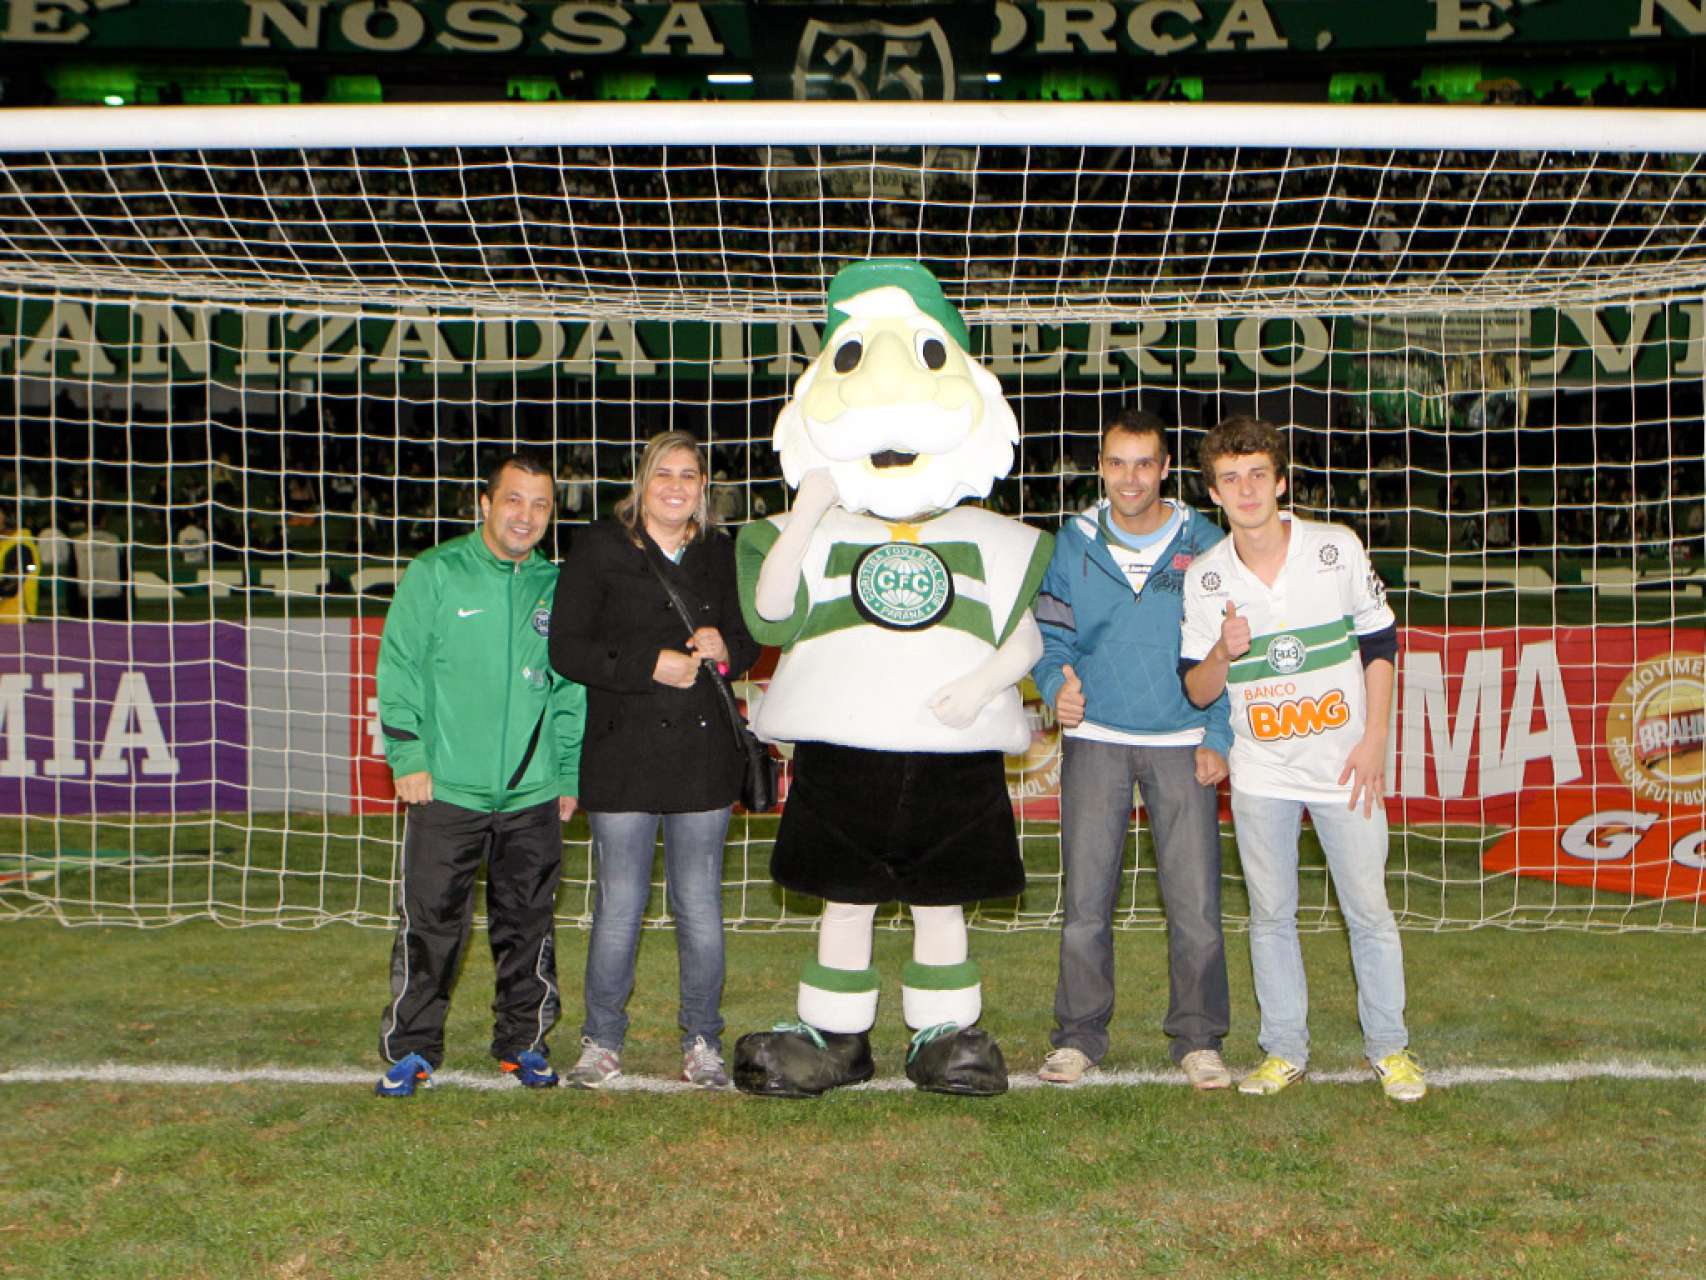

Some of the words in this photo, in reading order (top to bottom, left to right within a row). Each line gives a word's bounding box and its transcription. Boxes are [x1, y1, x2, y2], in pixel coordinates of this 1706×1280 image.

[240, 0, 724, 54] NOSSA
[0, 302, 656, 376] ANIZADA
[877, 570, 929, 593] CFC
[1244, 682, 1296, 701] BANCO
[1248, 690, 1349, 741] BMG
